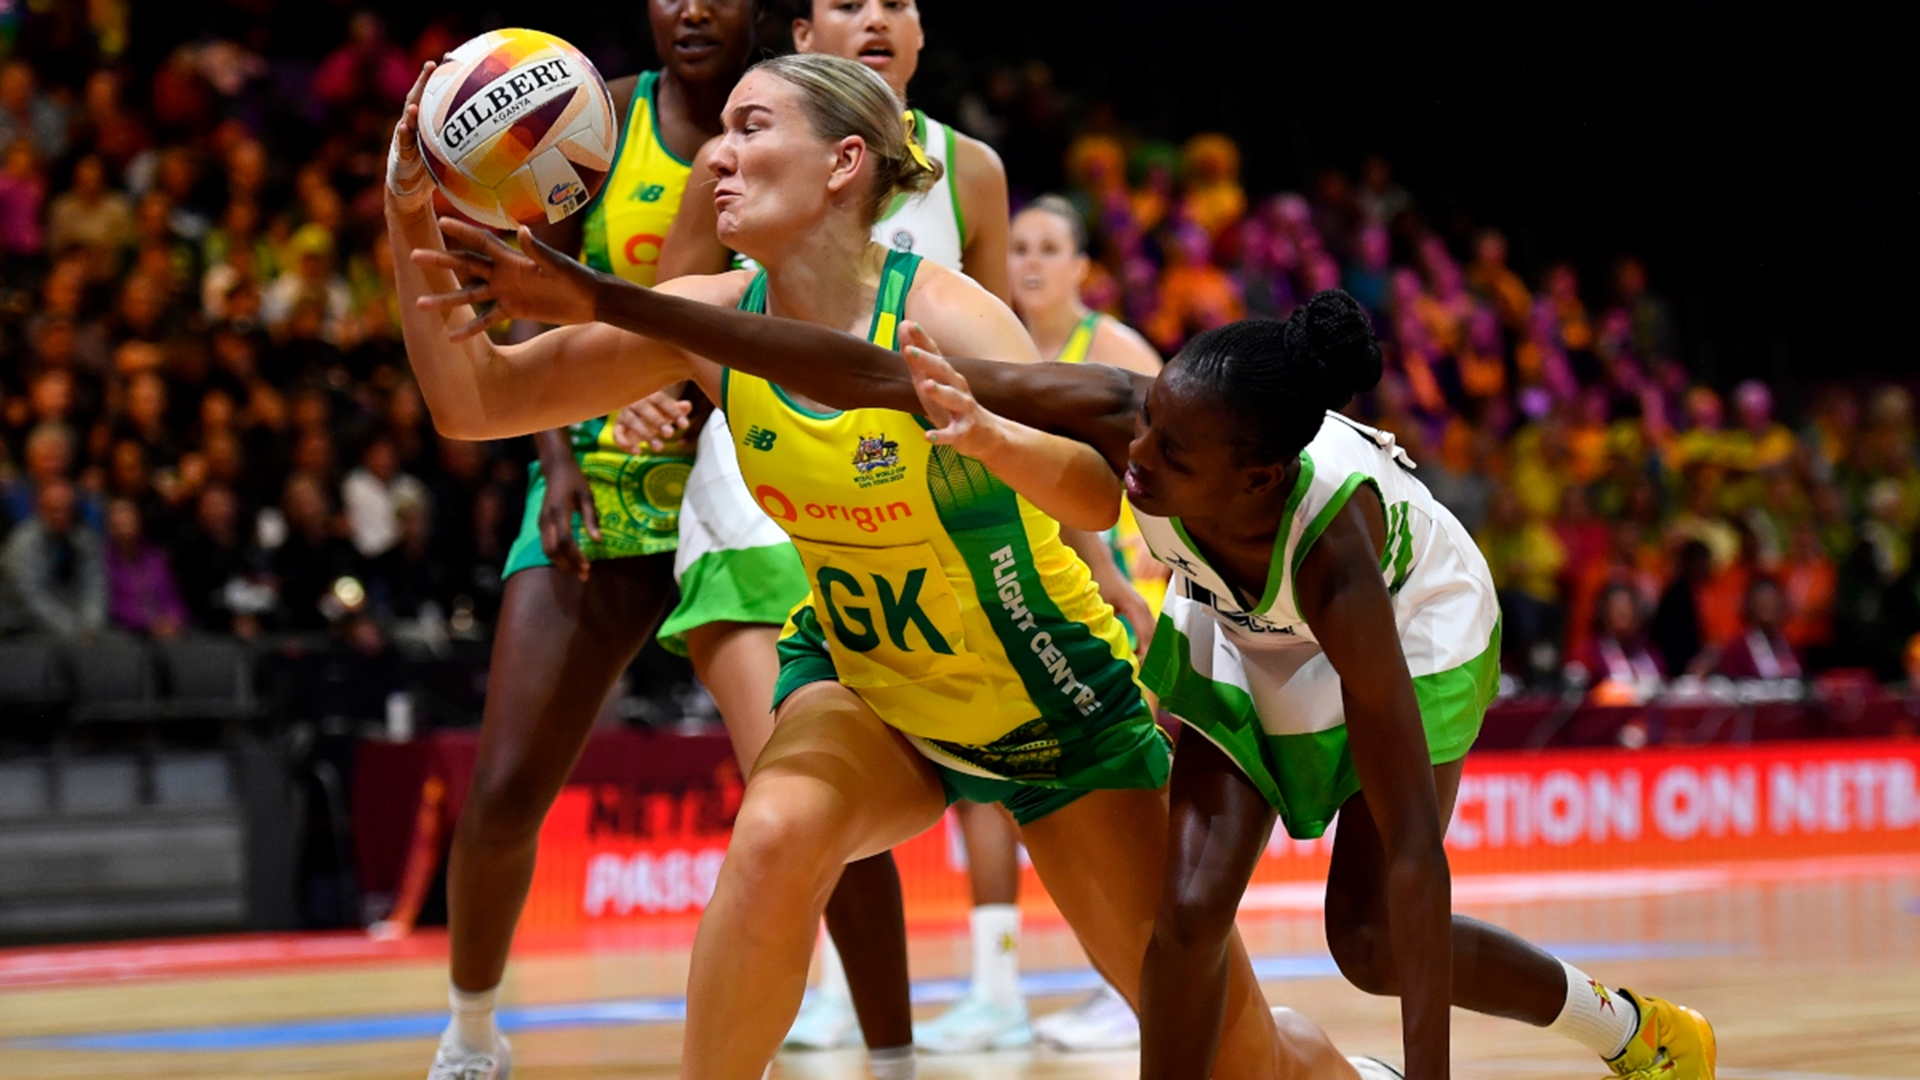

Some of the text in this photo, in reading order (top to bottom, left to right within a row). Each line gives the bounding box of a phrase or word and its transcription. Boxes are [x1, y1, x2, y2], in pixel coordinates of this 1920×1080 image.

[443, 58, 572, 149] GILBERT
[492, 97, 531, 125] KGANYA
[804, 501, 913, 533] origin
[816, 565, 958, 656] GK
[989, 544, 1038, 632] FLIGHT
[1652, 762, 1759, 841] ON
[1766, 758, 1920, 836] NETB
